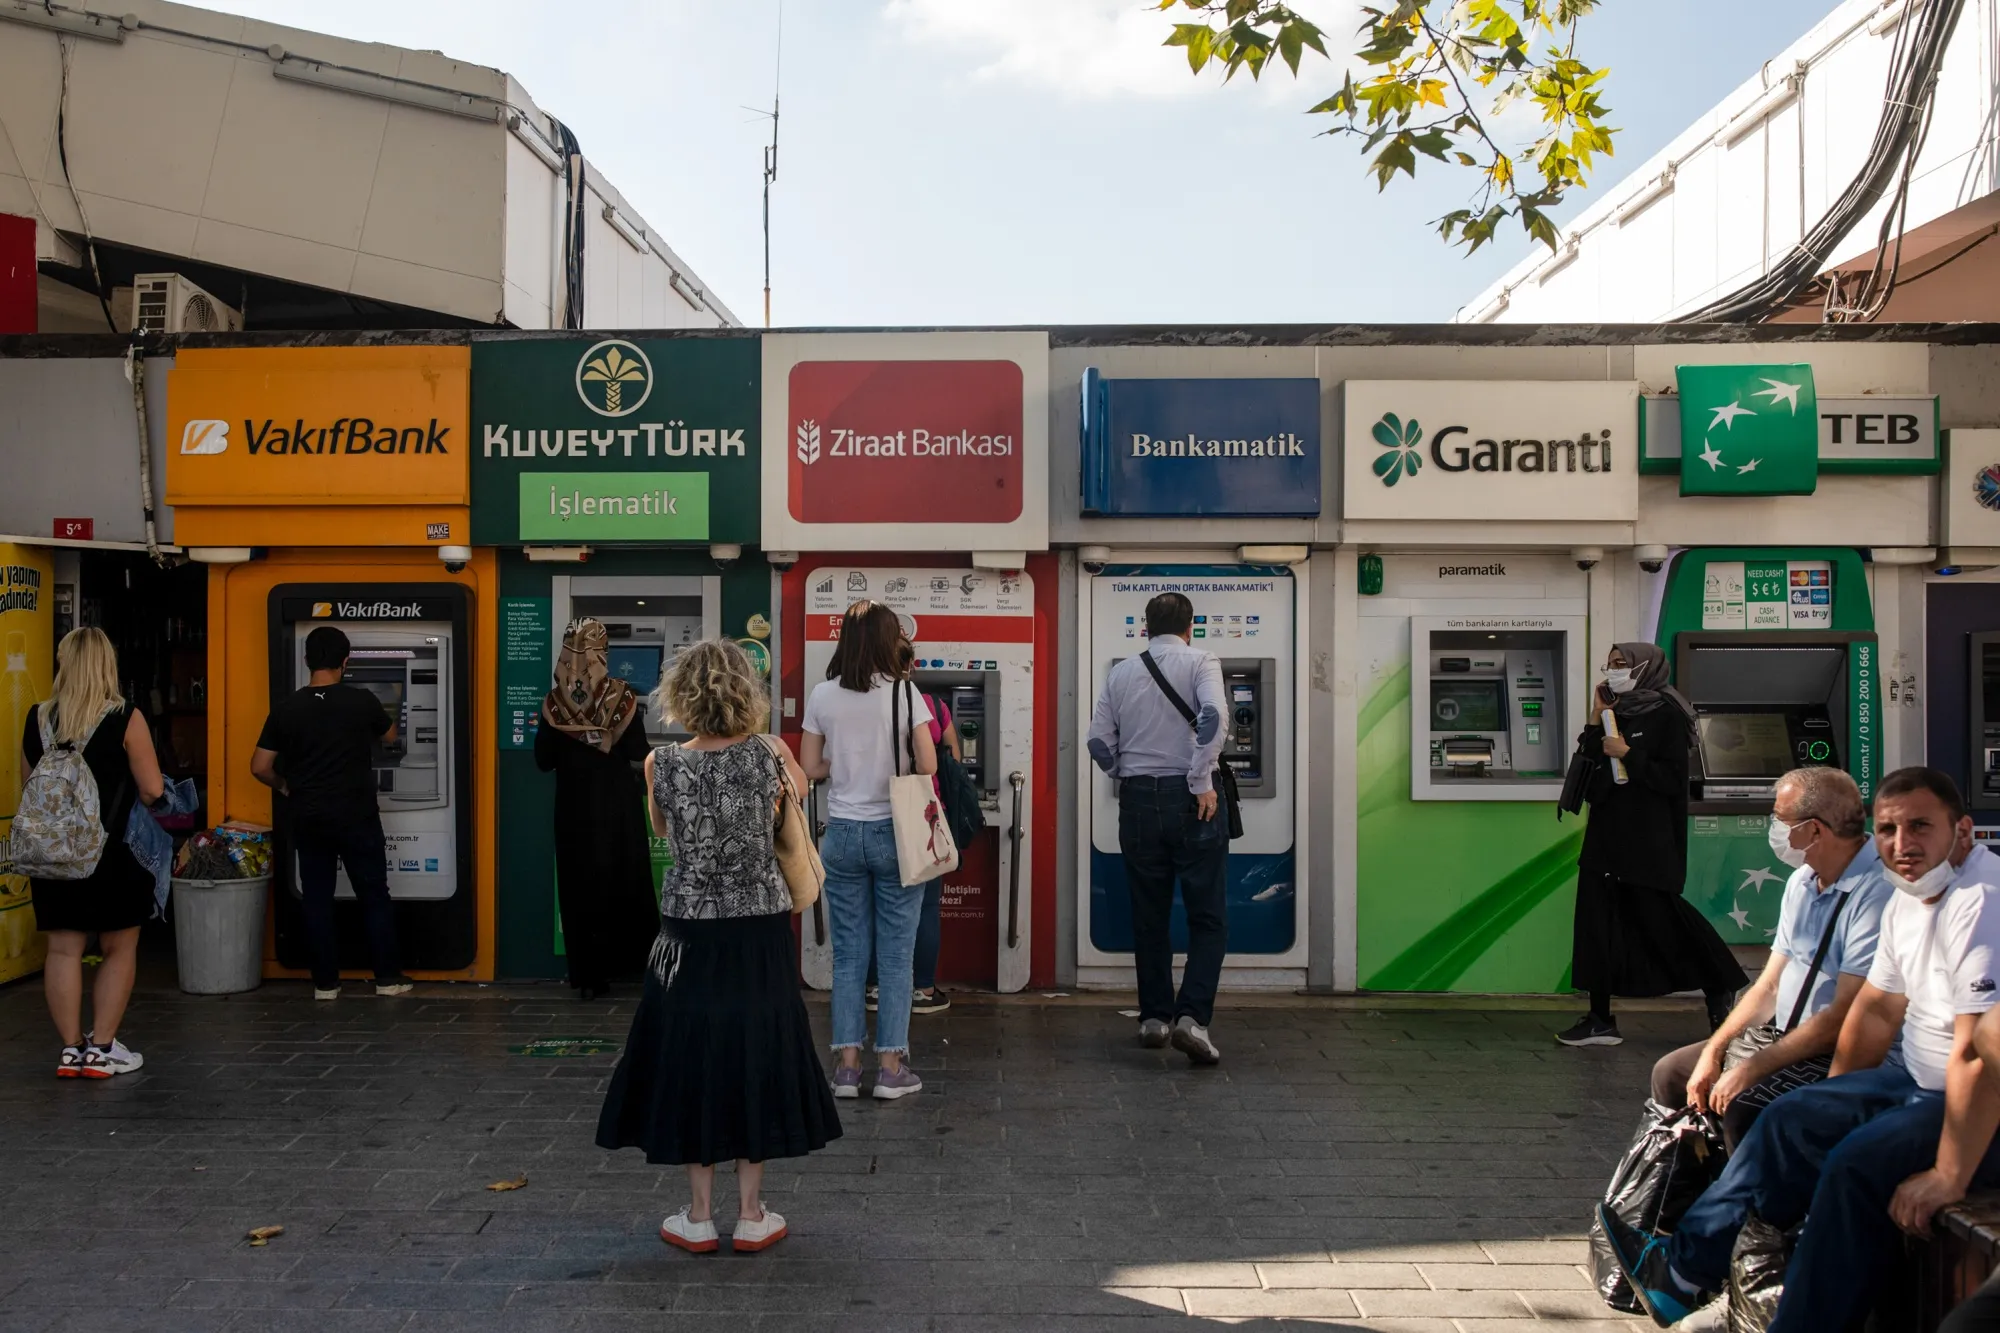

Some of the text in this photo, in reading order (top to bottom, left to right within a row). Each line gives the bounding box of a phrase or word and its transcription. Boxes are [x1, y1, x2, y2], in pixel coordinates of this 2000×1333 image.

[244, 417, 451, 455] VakıfBank
[1820, 414, 1920, 445] TEB
[829, 428, 1012, 457] Ziraat Bankası
[1130, 433, 1305, 458] Bankamatik
[1430, 426, 1612, 473] Garanti
[549, 485, 678, 519] İşlematik
[6, 565, 41, 589] yapımı
[1438, 563, 1506, 578] paramatik
[1747, 569, 1784, 578] NEED CASH?
[1112, 582, 1130, 592] TÜM
[1132, 583, 1181, 592] KARTLARIN
[1182, 583, 1211, 592] ORTAK
[0, 587, 38, 614] adında!
[337, 602, 423, 618] VakıfBank
[1465, 619, 1509, 627] bankaların
[1511, 620, 1553, 629] kartlarıyla
[1754, 616, 1780, 624] ADVANCE
[1793, 610, 1809, 618] VISA
[1812, 609, 1828, 620] troy
[1859, 646, 1870, 667] 666
[1859, 680, 1870, 700] 200
[1859, 702, 1870, 723] 850
[943, 883, 981, 896] İletişim
